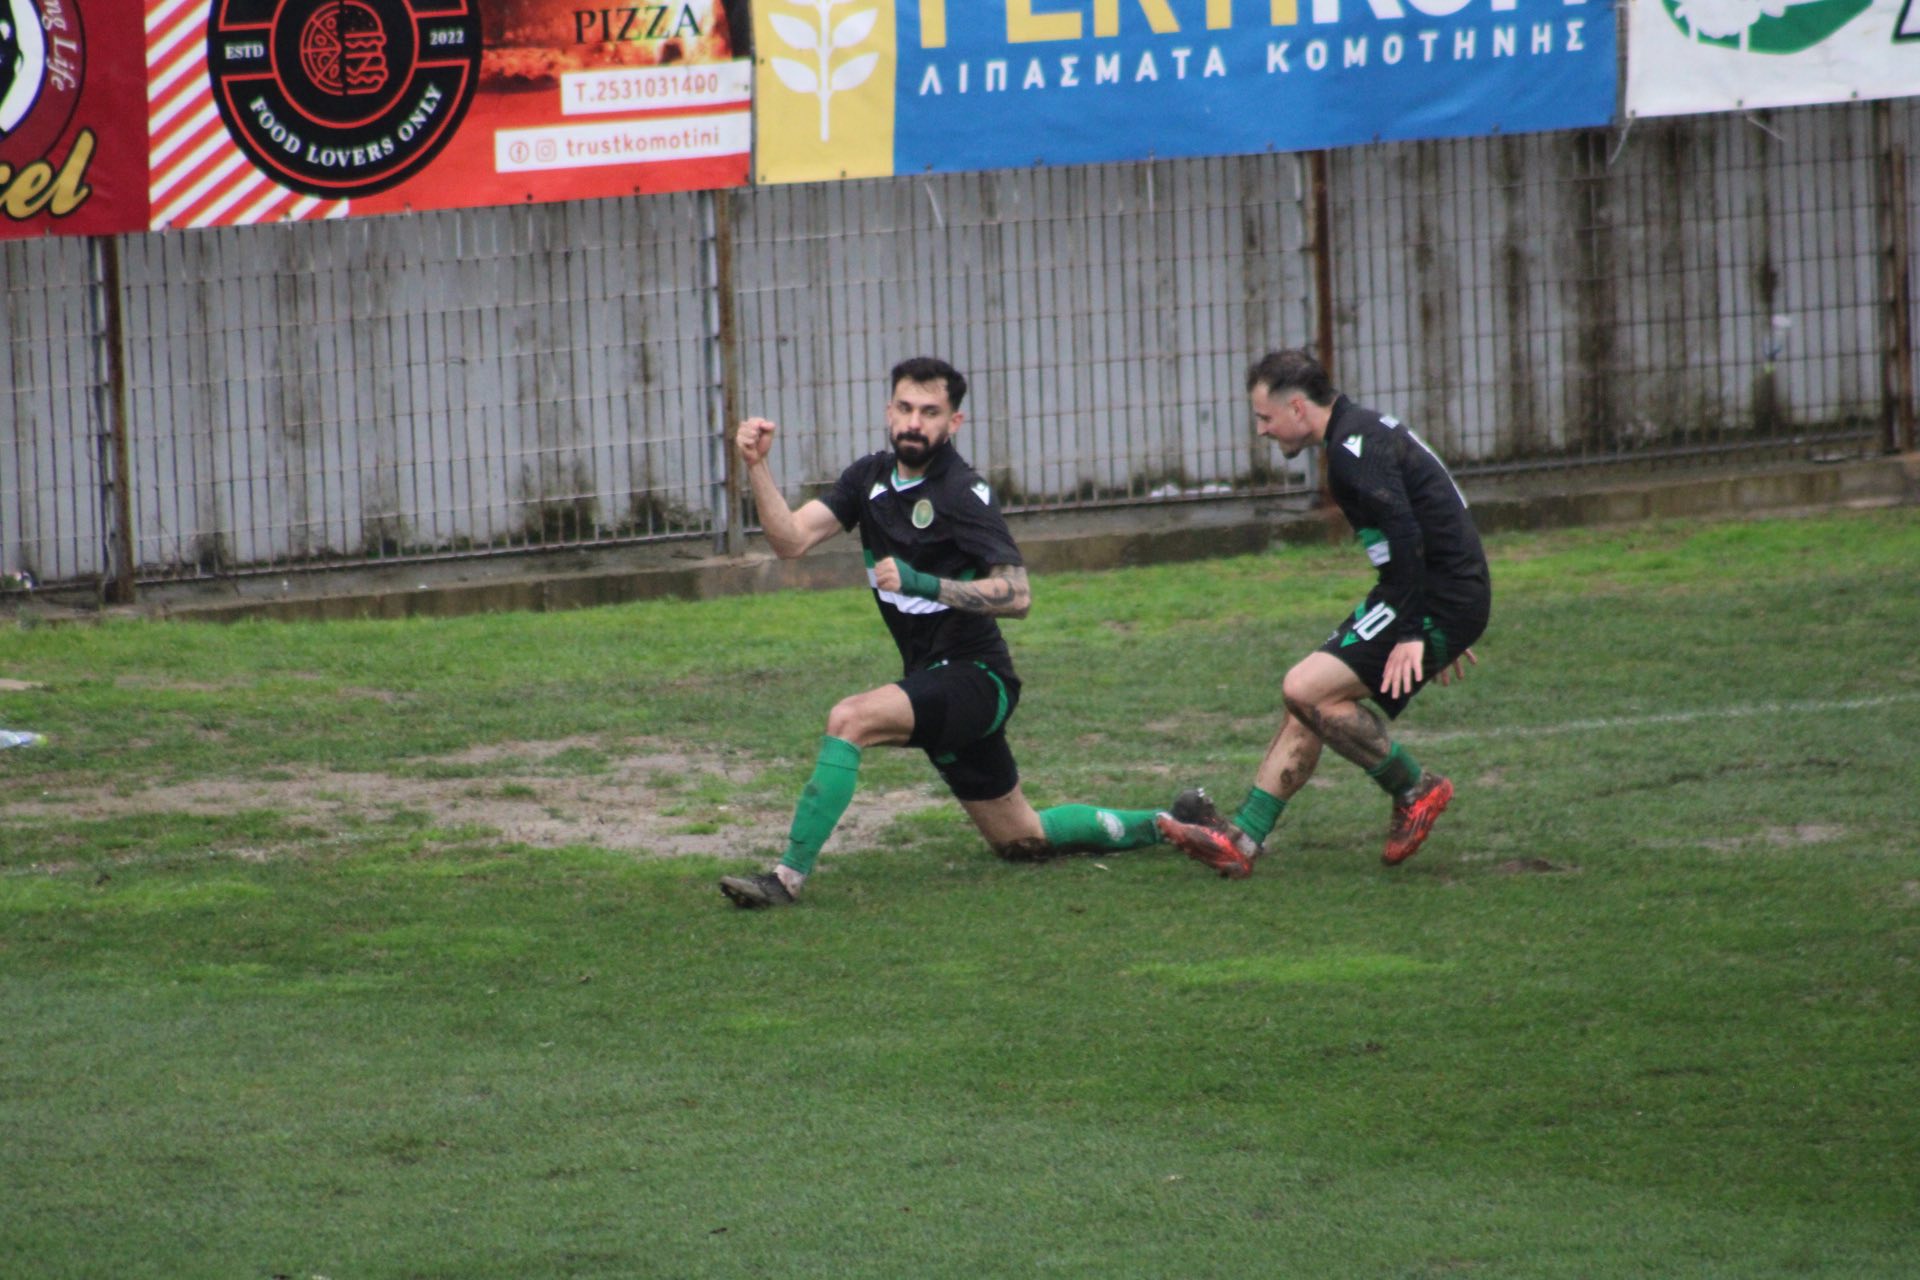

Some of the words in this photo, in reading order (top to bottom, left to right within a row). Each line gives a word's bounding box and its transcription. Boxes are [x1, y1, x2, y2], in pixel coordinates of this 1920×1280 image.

[429, 30, 465, 46] 2022
[574, 3, 704, 44] PIZZA
[46, 36, 77, 92] Life
[224, 43, 265, 60] ESTD
[919, 46, 1226, 95] ΛΙΠΑΣΜΑΤΑ
[1267, 20, 1585, 74] ΚΟΜΟΤΗΝΗΣ
[250, 97, 301, 154] FOOD
[306, 138, 396, 168] LOVERS
[397, 81, 443, 142] ONLY
[566, 126, 720, 157] trustkomotini
[1352, 601, 1397, 641] 10
